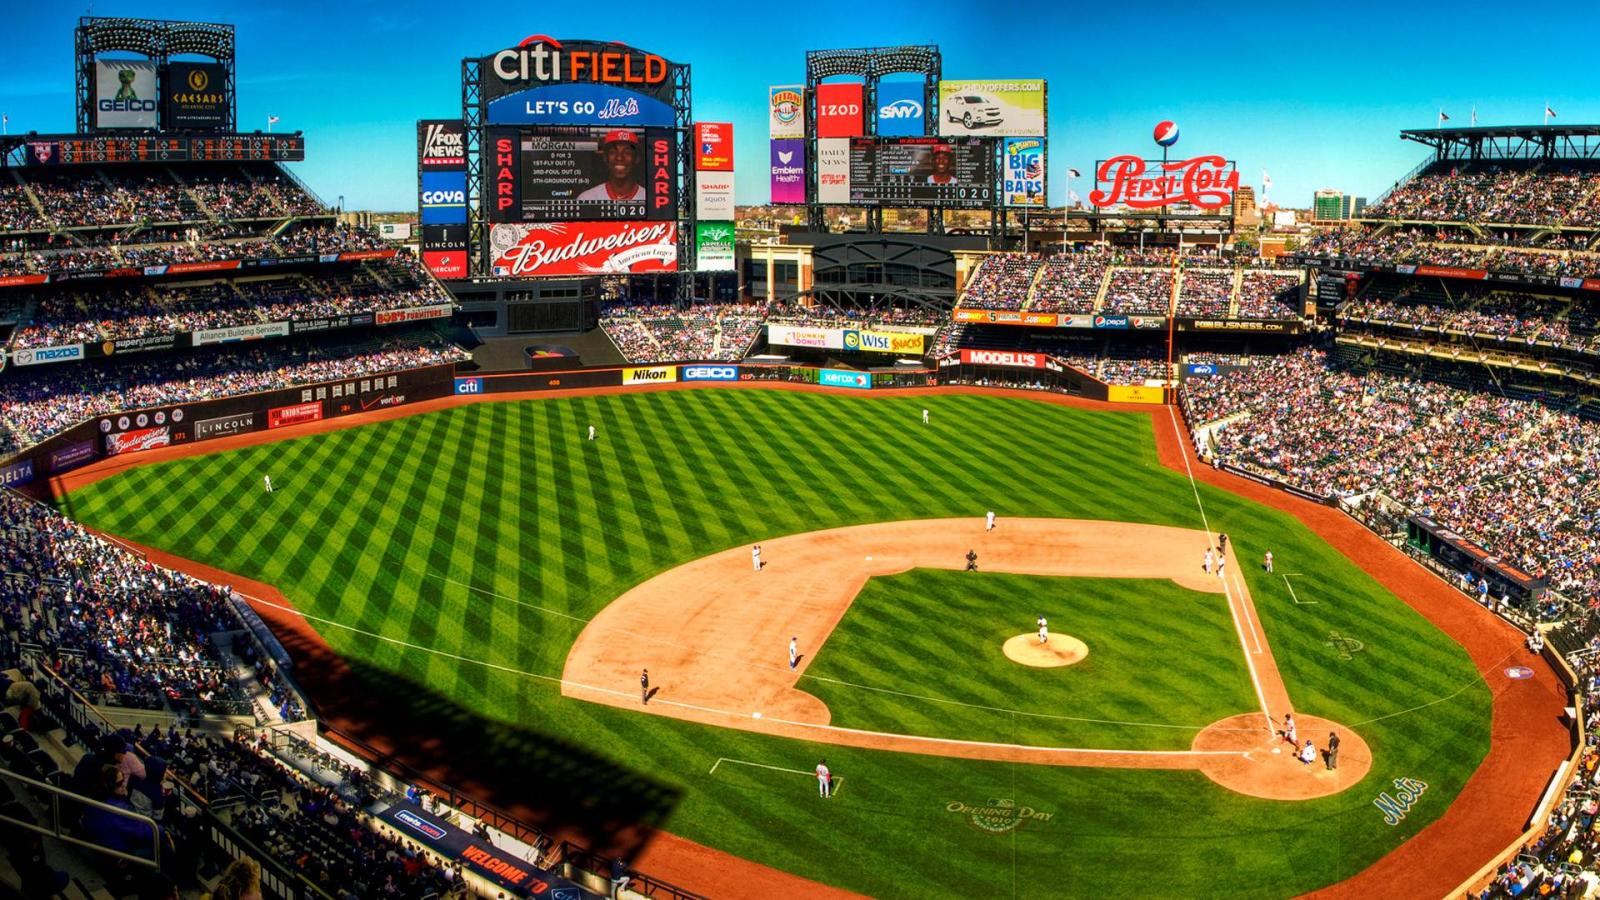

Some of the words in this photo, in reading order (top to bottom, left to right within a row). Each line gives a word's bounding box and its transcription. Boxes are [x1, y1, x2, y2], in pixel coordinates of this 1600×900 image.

[494, 43, 560, 80] citi
[570, 51, 667, 83] FIELD
[172, 93, 224, 104] CAESARS
[99, 100, 156, 112] GEICO
[526, 101, 569, 114] LET'S
[574, 101, 595, 114] GO
[598, 98, 640, 119] Mets
[821, 105, 859, 116] IZOD
[879, 105, 915, 119] SNY
[437, 133, 462, 145] FOX
[429, 146, 463, 157] NEWS
[1009, 153, 1040, 169] BIG
[497, 139, 513, 210] SHARP
[654, 140, 669, 208] SHARP
[772, 166, 803, 174] Emblem
[776, 174, 801, 182] Health
[1005, 180, 1042, 193] BARS
[422, 191, 465, 204] GOYA
[959, 188, 966, 198] 0
[971, 188, 978, 198] 2
[982, 189, 989, 198] 0
[620, 206, 626, 215] 0
[629, 207, 636, 215] 2
[639, 207, 646, 215] 0
[503, 224, 666, 275] Budweiser
[377, 311, 406, 323] BOB'S
[1106, 318, 1126, 327] pepsi
[200, 328, 227, 341] Alliance
[228, 327, 255, 340] Building
[255, 325, 283, 336] Services
[116, 335, 175, 347] superguarantee
[861, 335, 889, 349] WISE
[891, 337, 921, 350] SNACKS
[970, 351, 1036, 367] MODELL'S
[633, 369, 667, 381] Nikon
[685, 367, 735, 379] GEICO
[824, 373, 854, 384] xerox
[459, 381, 478, 393] citi
[380, 394, 405, 405] verizon
[202, 418, 253, 433] LINCOLN
[115, 426, 166, 452] Budweiser
[0, 466, 32, 485] DELTA
[1373, 777, 1428, 825] Mets
[398, 812, 442, 838] mets.com
[985, 816, 1012, 824] 2010
[462, 845, 528, 883] WELCOME
[524, 876, 549, 895] TO
